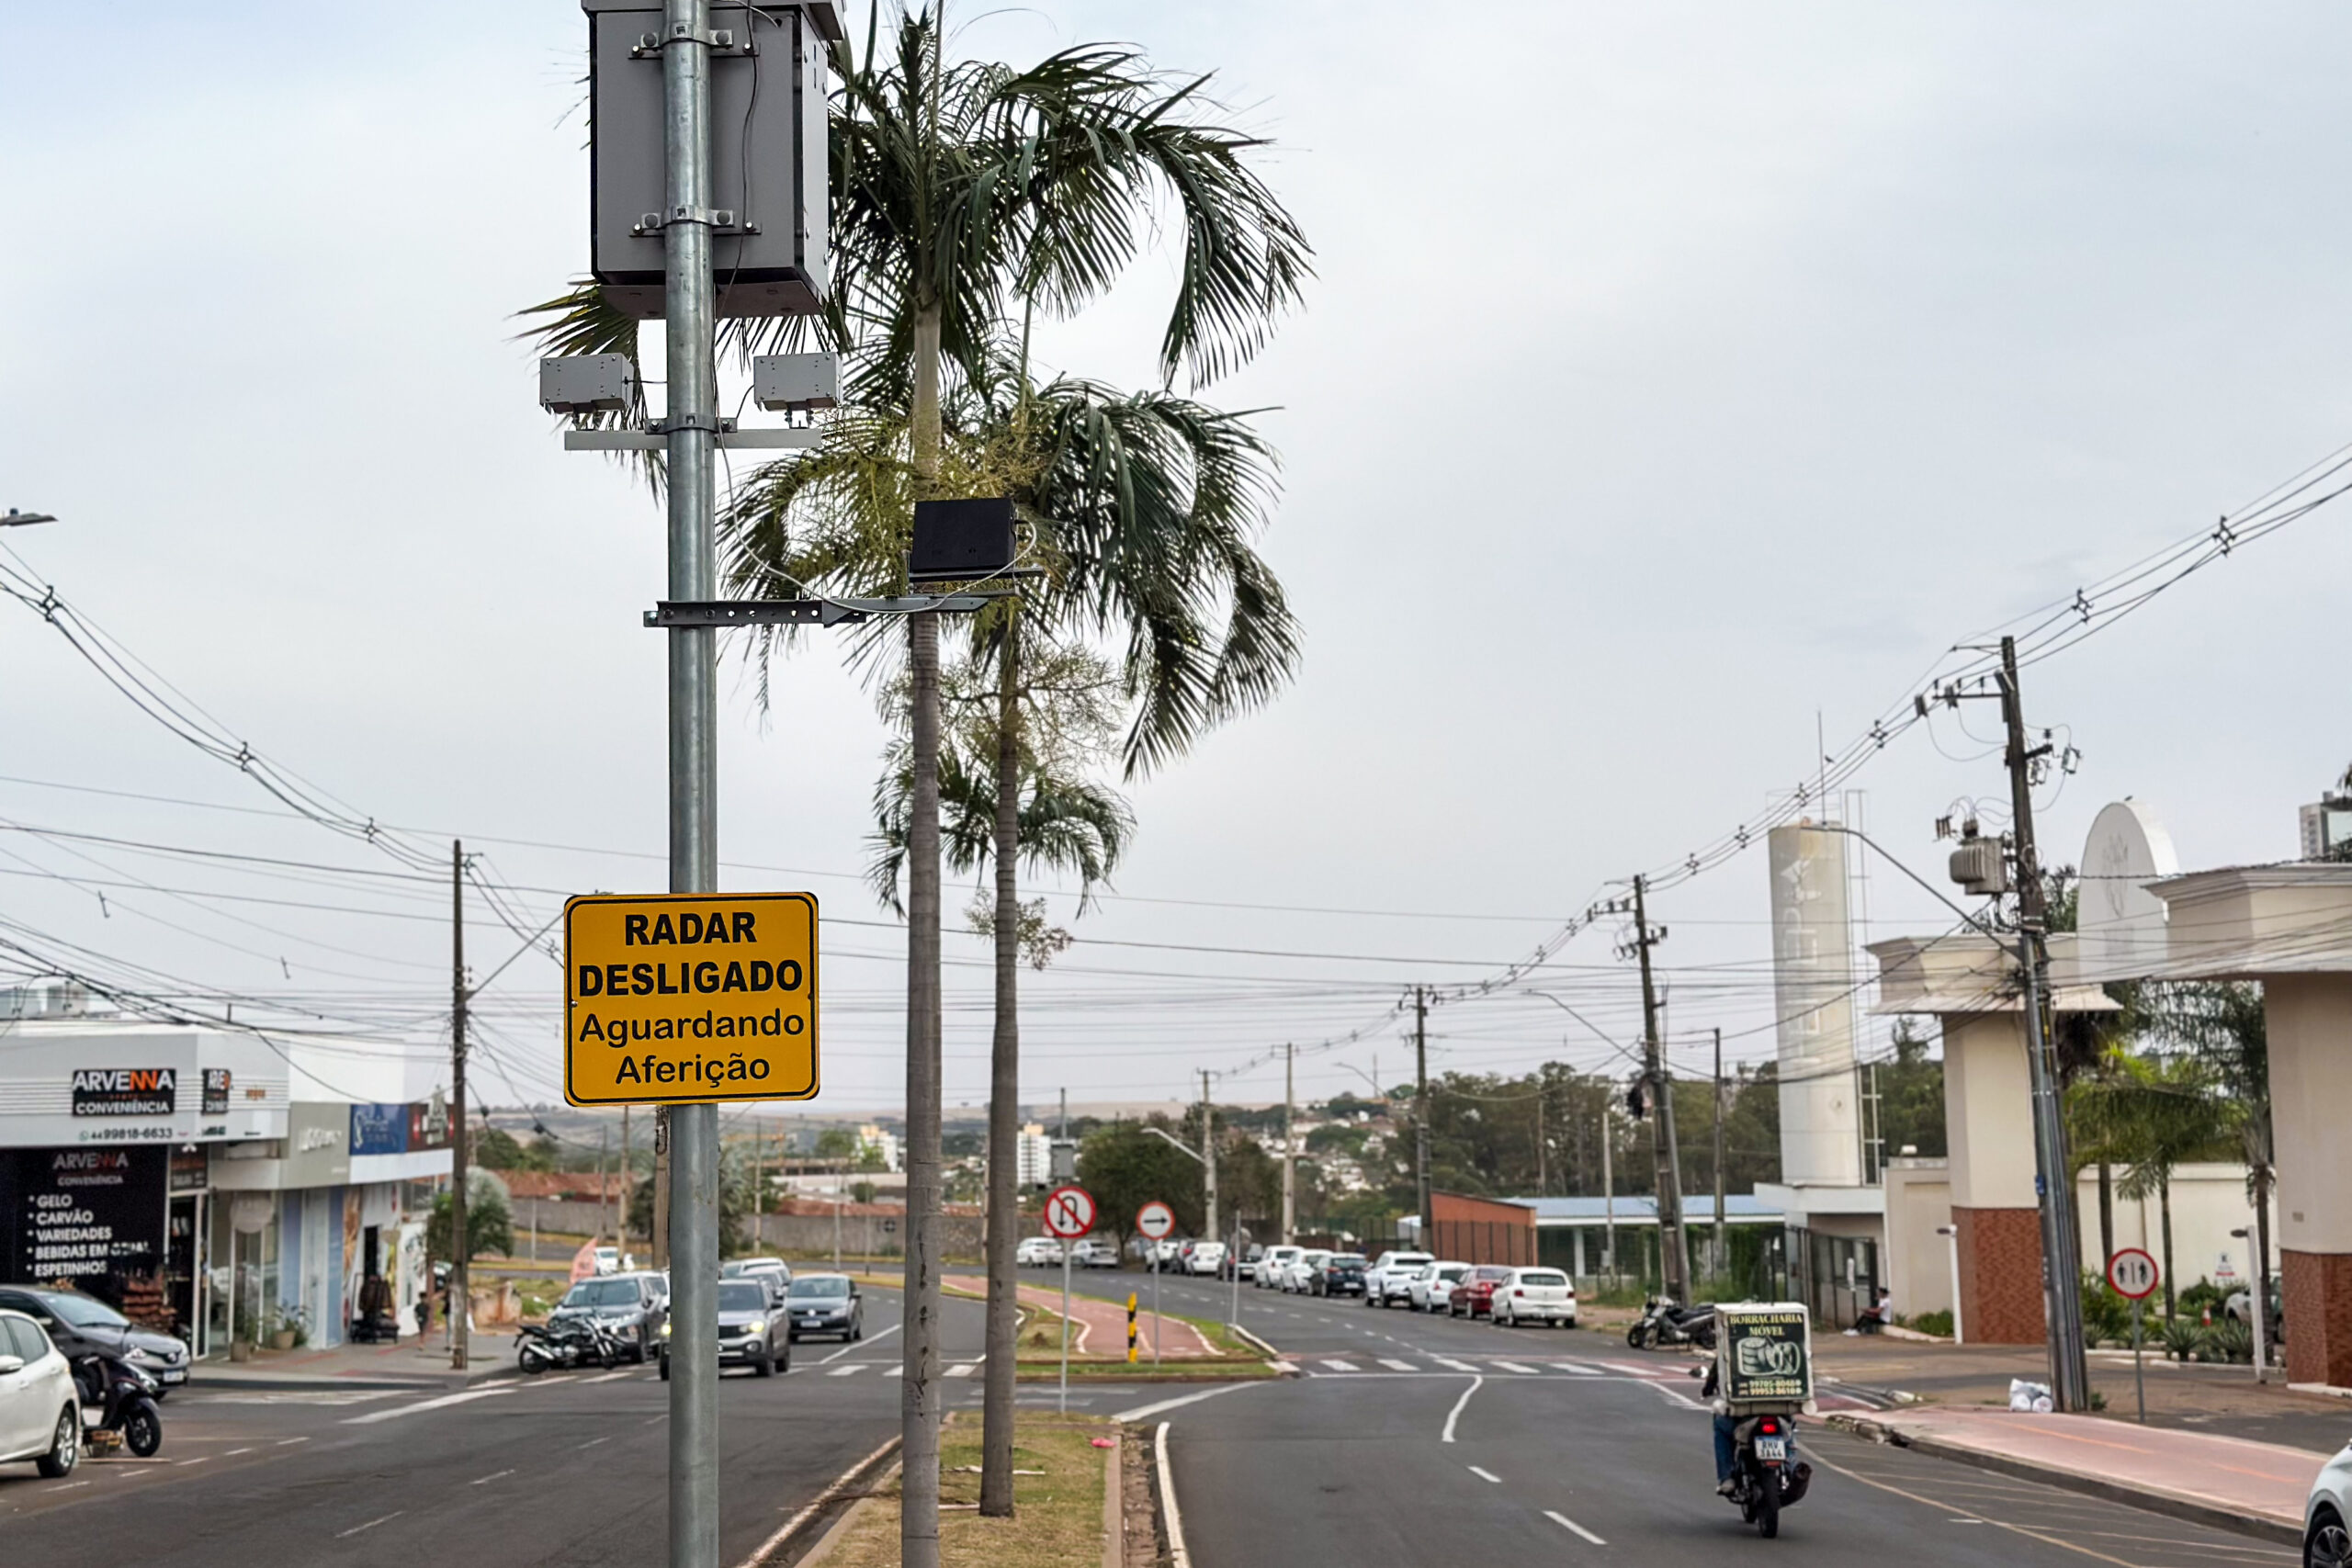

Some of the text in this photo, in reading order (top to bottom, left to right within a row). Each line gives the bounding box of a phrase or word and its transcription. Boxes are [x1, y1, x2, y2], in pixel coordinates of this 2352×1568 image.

[625, 912, 757, 945] RADAR
[579, 960, 803, 997] DESLIGADO
[579, 1008, 804, 1048] Aguardando
[616, 1053, 770, 1088] Aferição
[73, 1070, 174, 1090] ARVENNA
[76, 1100, 169, 1113] CONVENIÊNCIA
[52, 1152, 129, 1169] ARVENNA
[37, 1194, 73, 1208] GELO
[37, 1209, 94, 1224] CARVÃO
[37, 1226, 112, 1241] VARIEDADES
[35, 1246, 86, 1259] BEBIDAS
[89, 1244, 108, 1257] EM
[35, 1260, 107, 1277] ESPETINHOS
[1729, 1314, 1803, 1324] BORRACHARIA
[1748, 1325, 1785, 1337] MÓVEL
